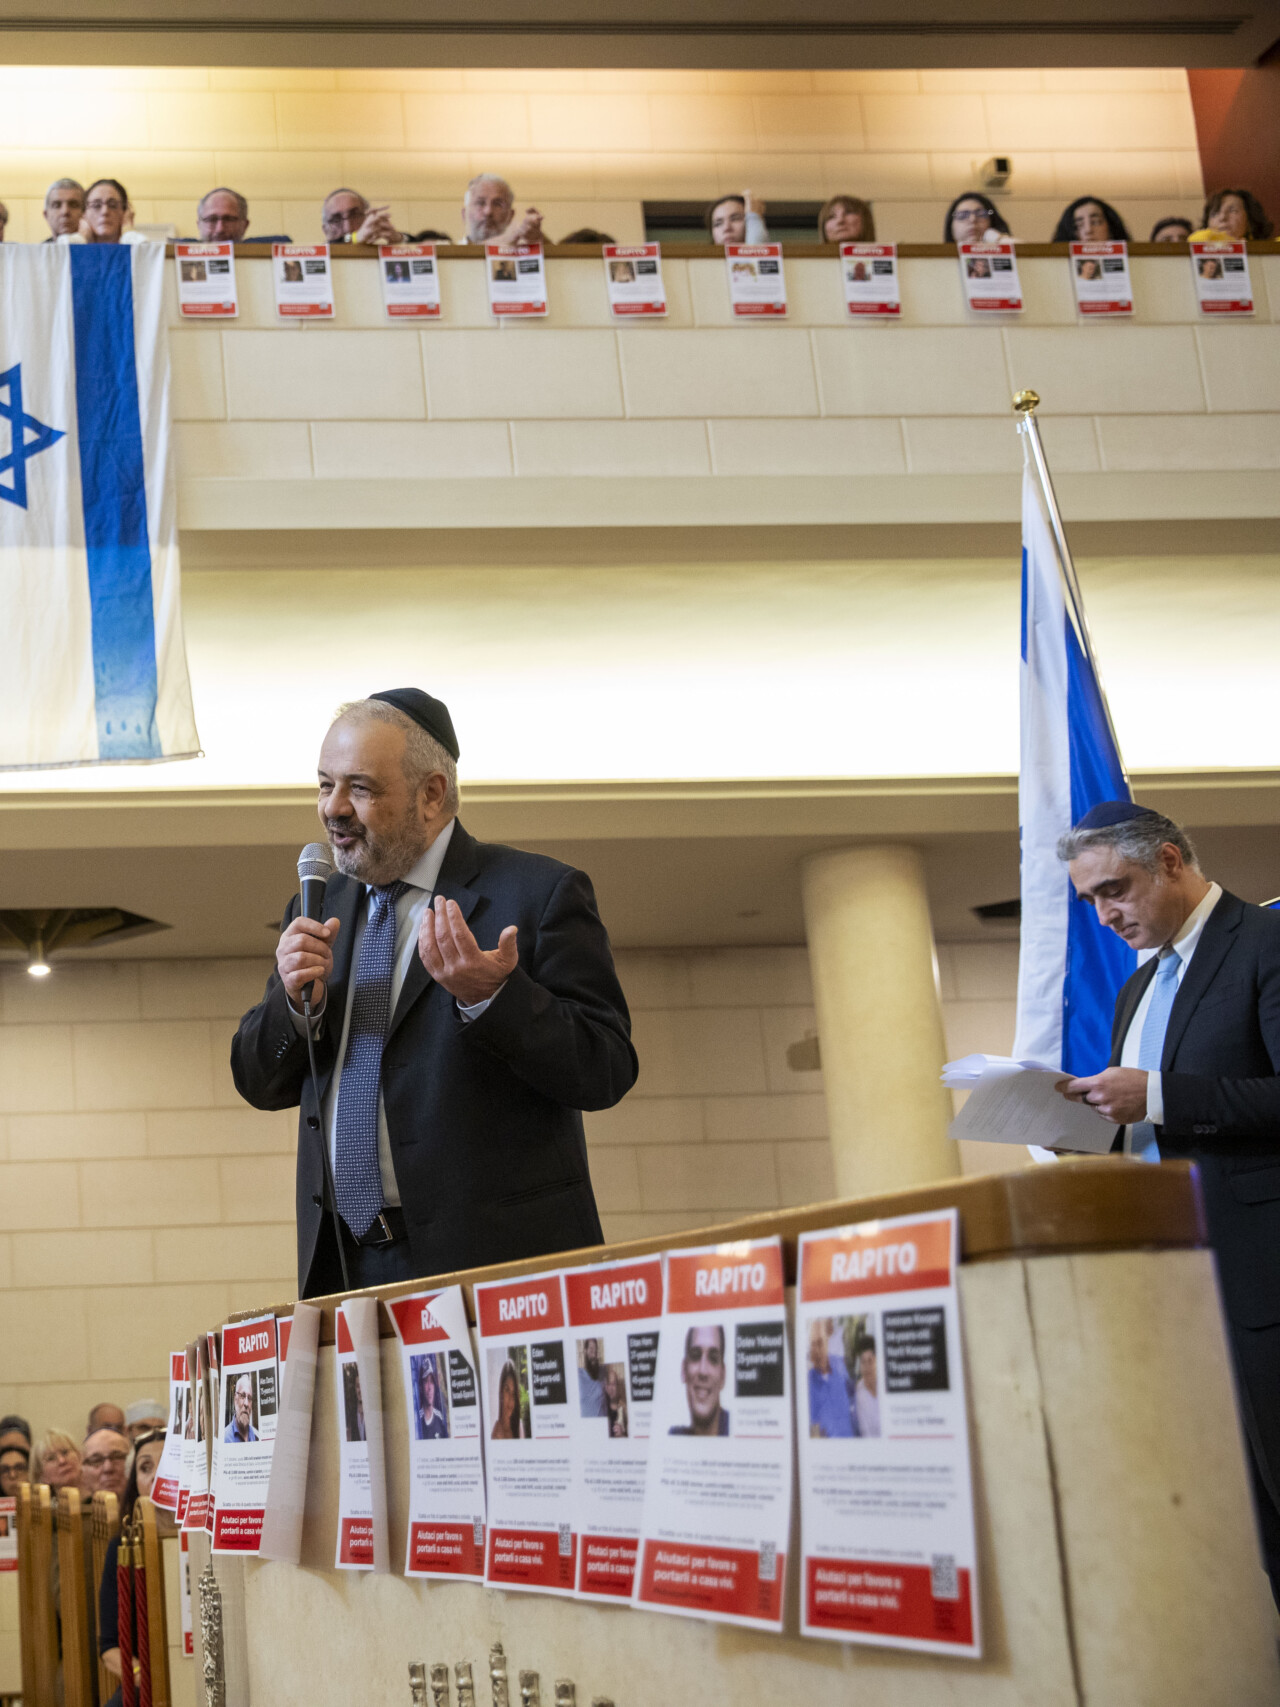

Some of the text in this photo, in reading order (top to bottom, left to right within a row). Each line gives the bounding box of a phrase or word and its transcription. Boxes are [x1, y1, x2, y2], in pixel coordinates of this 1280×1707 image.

[831, 1242, 917, 1283] RAPITO
[695, 1262, 766, 1297] RAPITO
[590, 1278, 647, 1310] RAPITO
[498, 1292, 548, 1321] RAPITO
[238, 1332, 269, 1354] RAPITO
[221, 1516, 239, 1524] Aiutaci
[350, 1525, 367, 1535] Aiutaci
[417, 1530, 435, 1541] Aiutaci
[436, 1532, 444, 1542] per
[495, 1537, 513, 1548] Aiutaci
[514, 1540, 522, 1550] per
[523, 1540, 539, 1550] favore
[587, 1545, 608, 1557] Aiutaci
[609, 1548, 620, 1559] per
[656, 1551, 689, 1566] Aiutaci
[691, 1556, 705, 1570] per
[707, 1557, 730, 1570] favore
[616, 1566, 630, 1574] casa
[654, 1569, 689, 1582] portarli
[692, 1576, 698, 1584] a
[699, 1577, 718, 1587] casa
[815, 1569, 846, 1583] Aiutaci
[848, 1574, 862, 1587] per
[863, 1572, 892, 1588] favore
